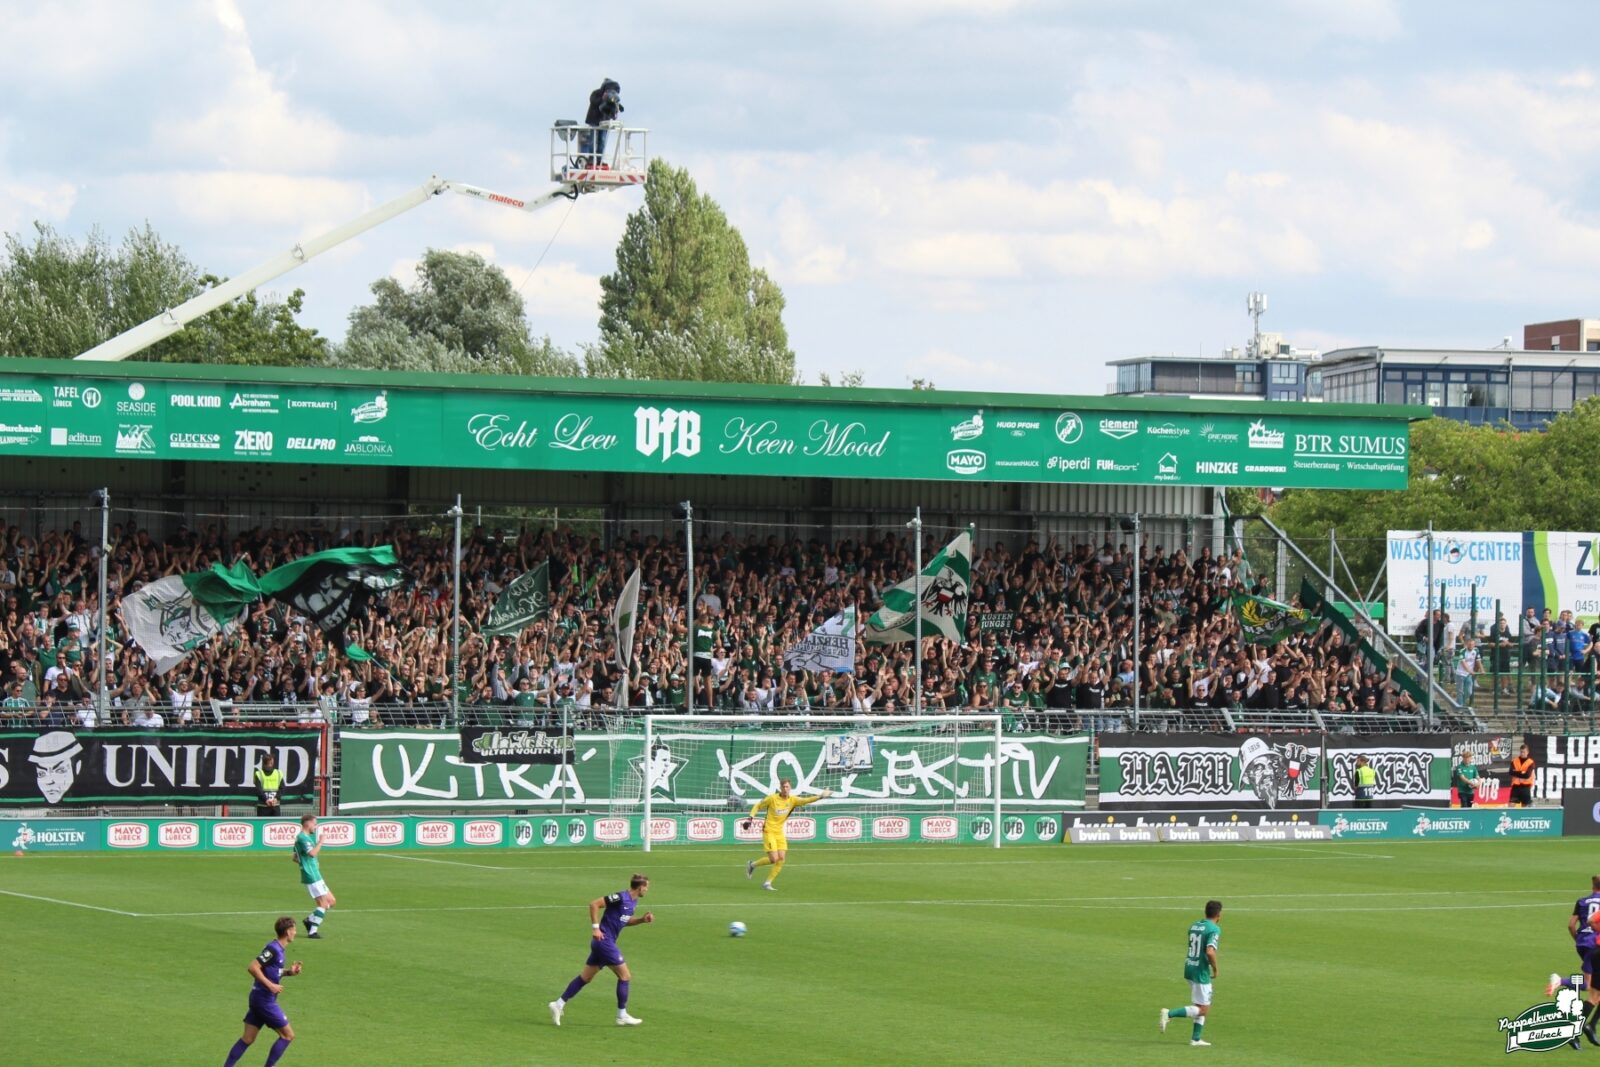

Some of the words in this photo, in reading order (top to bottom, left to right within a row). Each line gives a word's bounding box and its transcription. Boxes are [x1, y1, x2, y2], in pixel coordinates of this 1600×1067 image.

[489, 193, 524, 208] mateco
[53, 386, 79, 398] TAFEL
[170, 394, 197, 407] POOL
[116, 401, 156, 413] SEASIDE
[1100, 419, 1138, 429] clement
[467, 413, 539, 451] Echt
[634, 406, 701, 463] VfB
[719, 416, 797, 456] Keen
[803, 419, 891, 457] Mood
[286, 437, 336, 450] DELLPRO
[344, 444, 393, 453] JABLONKA
[1295, 434, 1333, 453] BTR
[1339, 435, 1406, 455] SUMUS
[950, 455, 982, 466] MAYO
[1059, 457, 1090, 472] iperdi
[1294, 460, 1340, 471] Steuerberatung
[1196, 462, 1238, 474] HINZKE
[1390, 540, 1442, 560] WASCH
[1469, 541, 1521, 561] CENTER
[1475, 575, 1488, 588] 97
[481, 748, 515, 757] ULTRA
[102, 744, 310, 788] UNITED
[165, 826, 192, 834] MAYO
[220, 826, 246, 834] MAYO
[270, 826, 296, 834] MAYO
[322, 825, 349, 833] MAYO
[568, 823, 584, 836] VfB
[971, 822, 990, 834] VfB
[1004, 822, 1022, 834] VfB
[1036, 822, 1056, 835] VfB
[1350, 822, 1388, 831] HOLSTEN
[1432, 820, 1470, 830] HOLSTEN
[1514, 820, 1550, 829] HOLSTEN
[37, 832, 85, 843] HOLSTEN
[515, 825, 531, 839] VfB
[542, 825, 557, 838] VfB
[1079, 828, 1111, 840] bwin
[1120, 828, 1151, 840] bwin
[1169, 828, 1200, 840] bwin
[1208, 828, 1239, 840] bwin
[1256, 828, 1286, 839] bwin
[1294, 828, 1324, 839] bwin
[1189, 932, 1202, 958] 31
